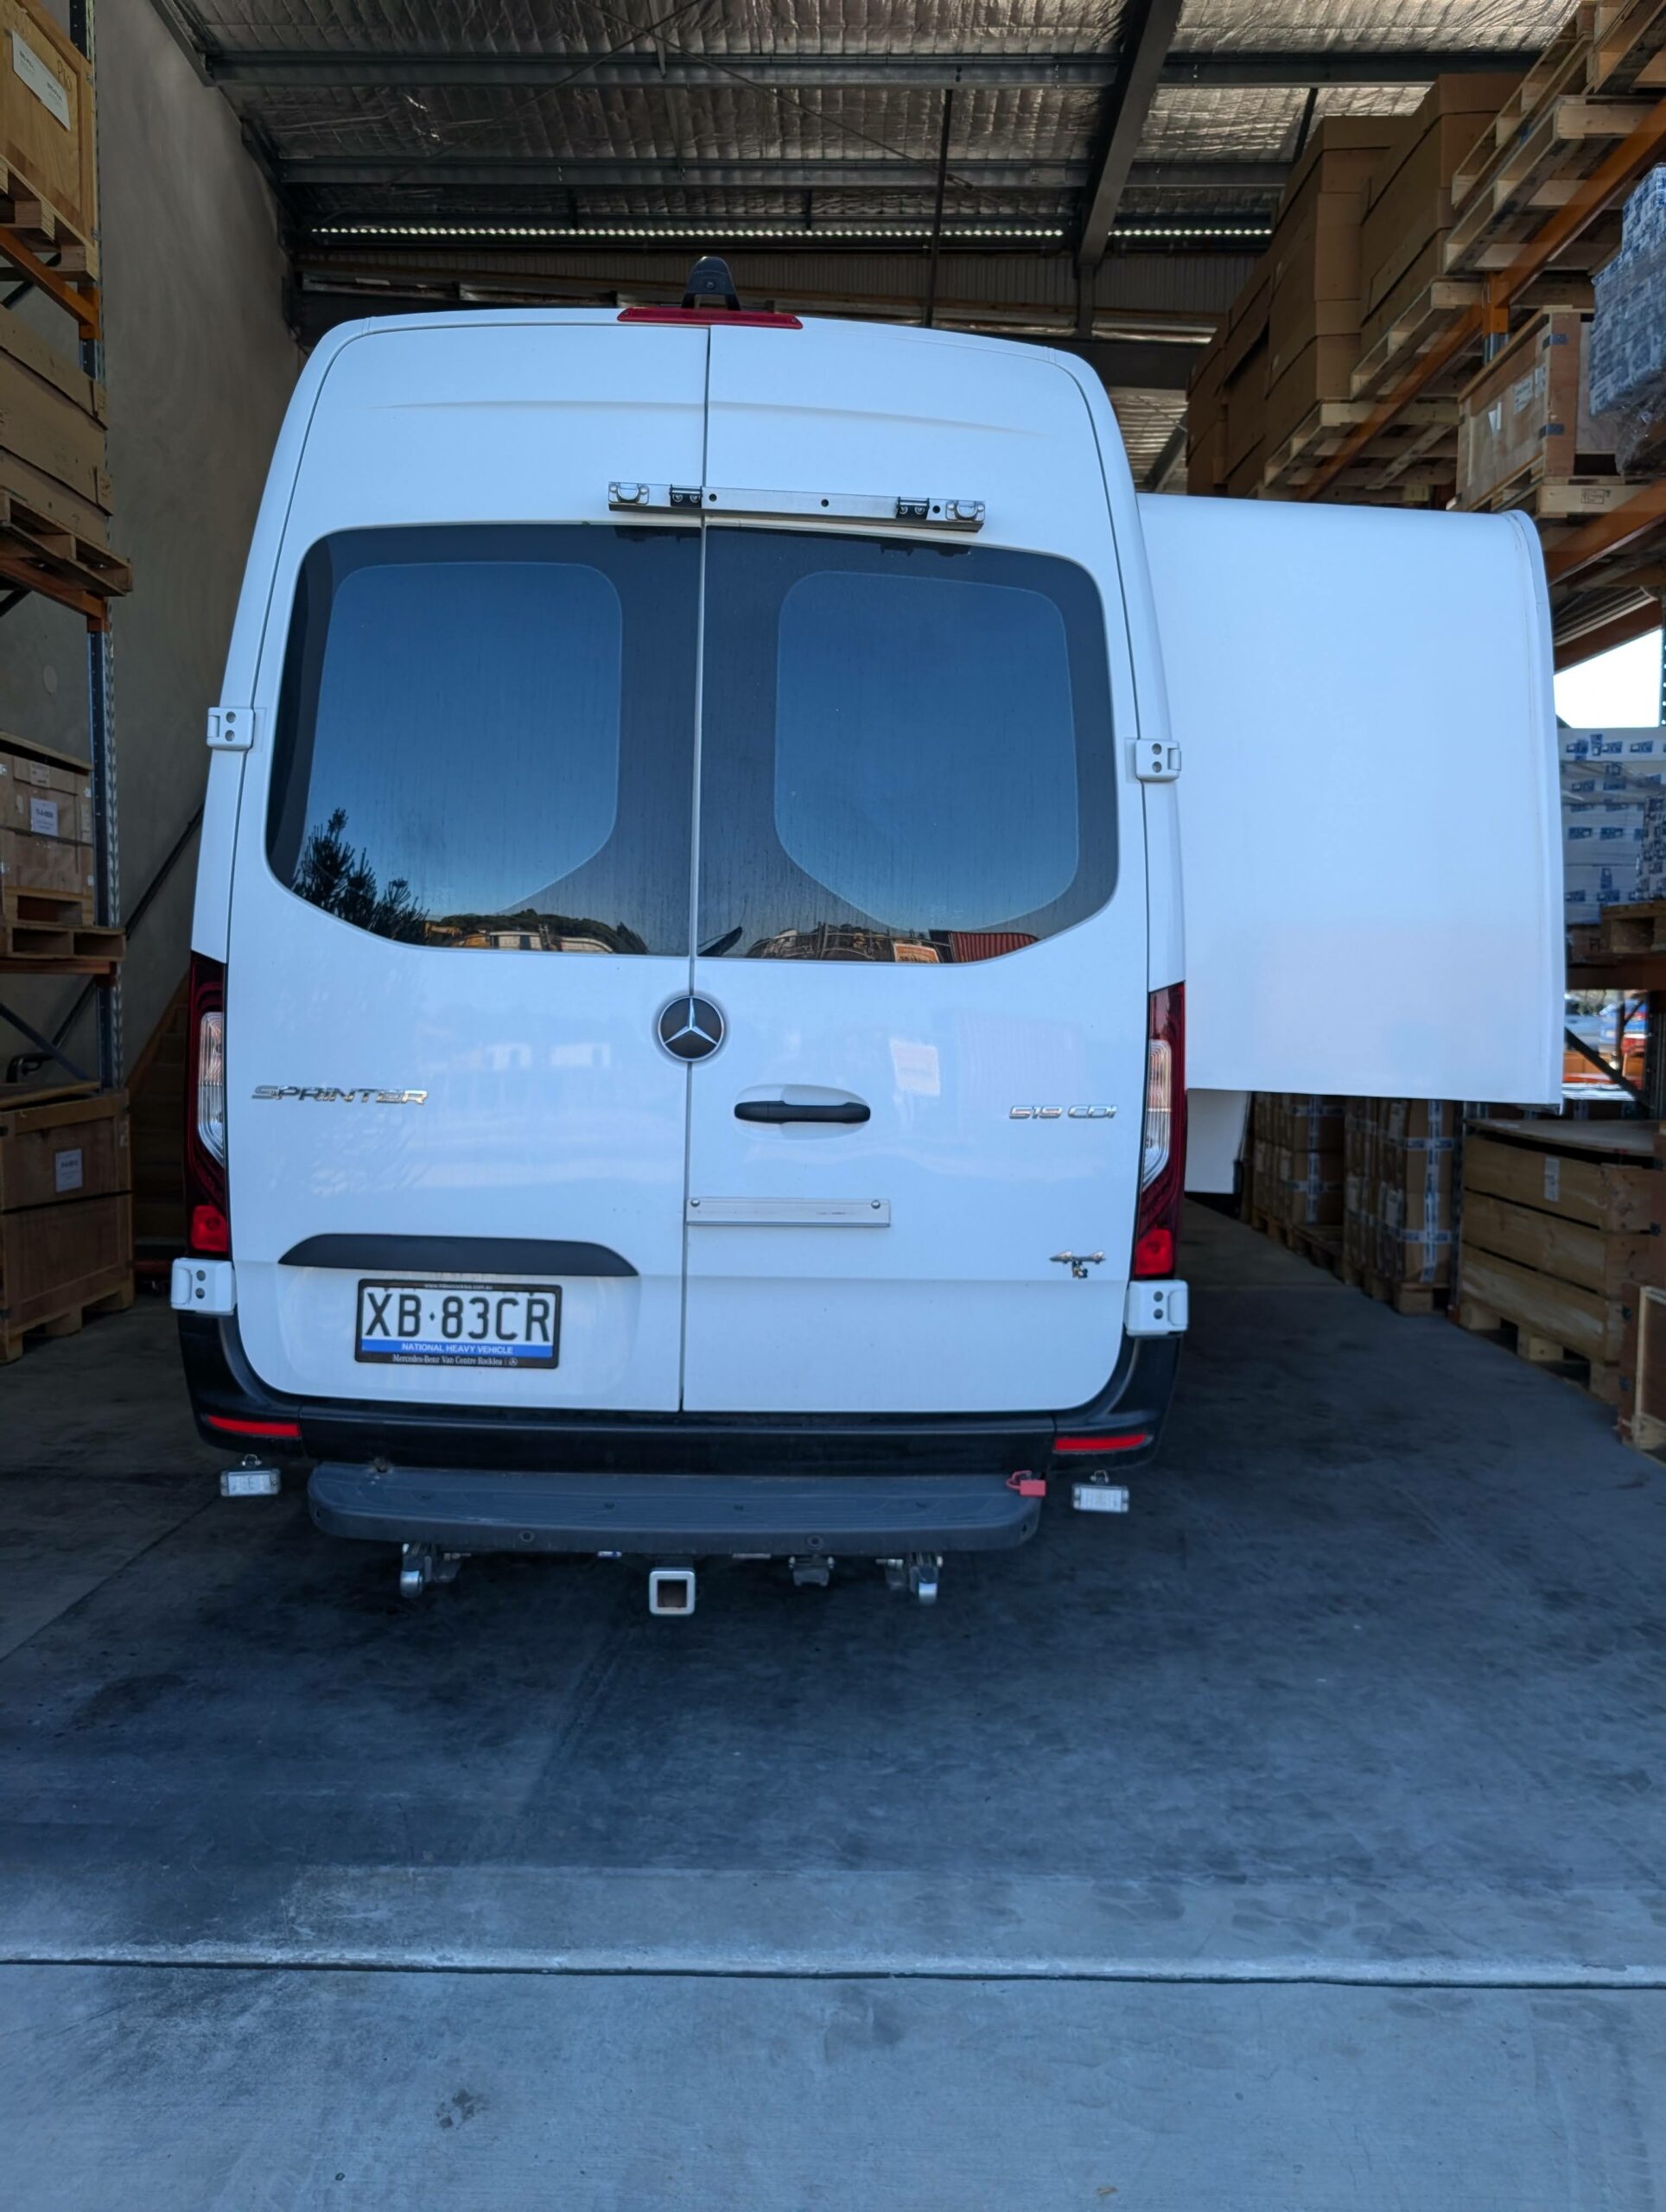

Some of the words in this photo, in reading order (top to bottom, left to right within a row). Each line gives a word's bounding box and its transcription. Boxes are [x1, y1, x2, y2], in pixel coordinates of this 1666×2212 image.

[251, 1085, 429, 1105] SPRINTER
[1008, 1105, 1063, 1120] 519
[1067, 1105, 1118, 1120] CDI
[401, 1342, 444, 1353] NATIONAL
[445, 1344, 476, 1354] HEAVY
[477, 1345, 514, 1355] VEHICLE
[392, 1353, 440, 1364] Mercedes-Benz
[442, 1355, 454, 1364] Van
[455, 1356, 477, 1365] Centre
[478, 1357, 503, 1366] Rocklea
